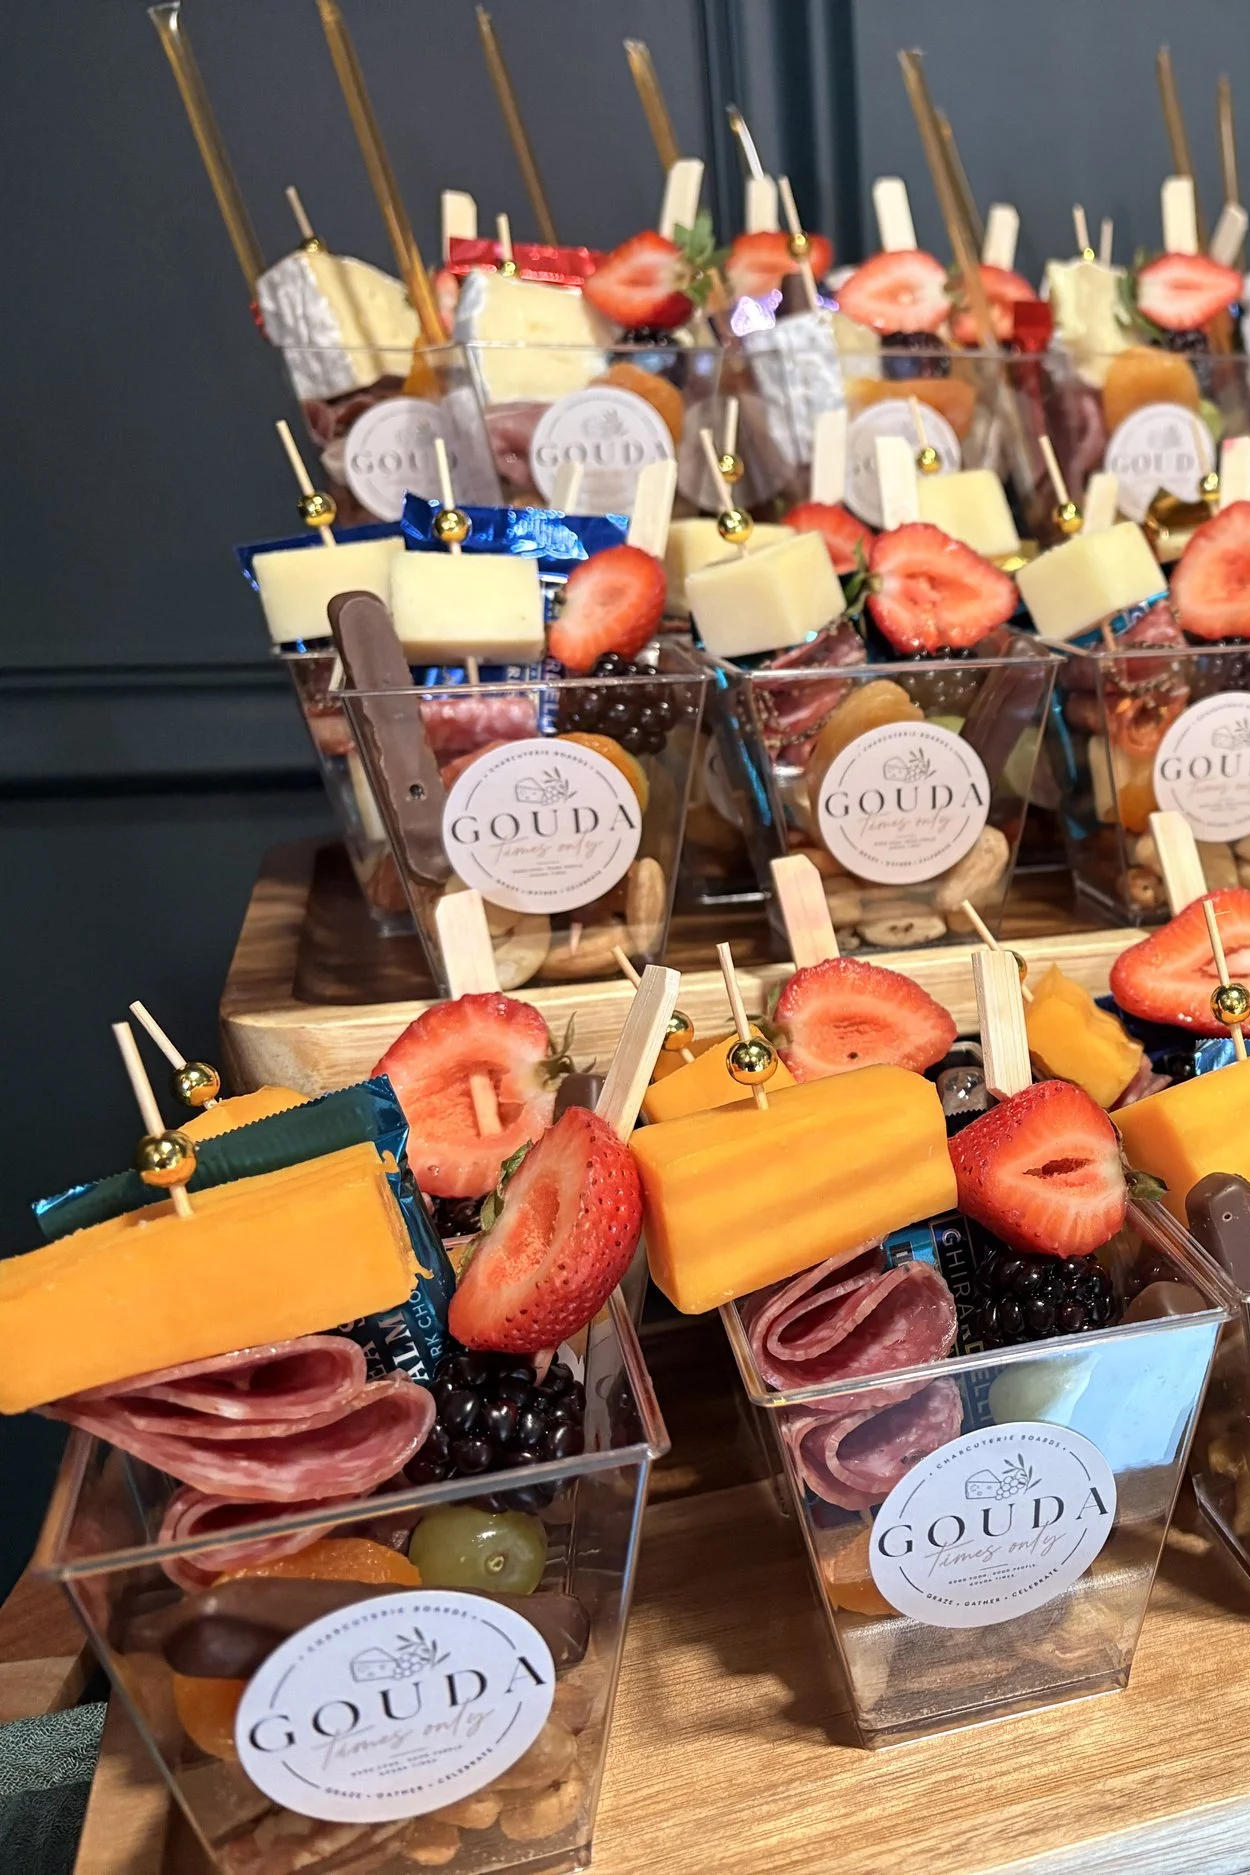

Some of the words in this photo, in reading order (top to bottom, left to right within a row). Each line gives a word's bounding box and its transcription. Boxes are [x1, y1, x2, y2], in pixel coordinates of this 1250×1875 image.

[825, 782, 984, 818] GOUDA
[451, 803, 636, 845] GOUDA
[937, 1435, 1014, 1469] CHARCUTERIE
[1021, 1434, 1060, 1448] BOARDS
[878, 1486, 1109, 1558] GOUDA
[1008, 1520, 1066, 1556] only
[926, 1592, 953, 1606] GRAZE
[964, 1597, 1001, 1607] GATHER
[1012, 1567, 1059, 1597] CELEBRATE
[248, 1655, 548, 1753] GOUDA
[422, 1697, 495, 1738] only
